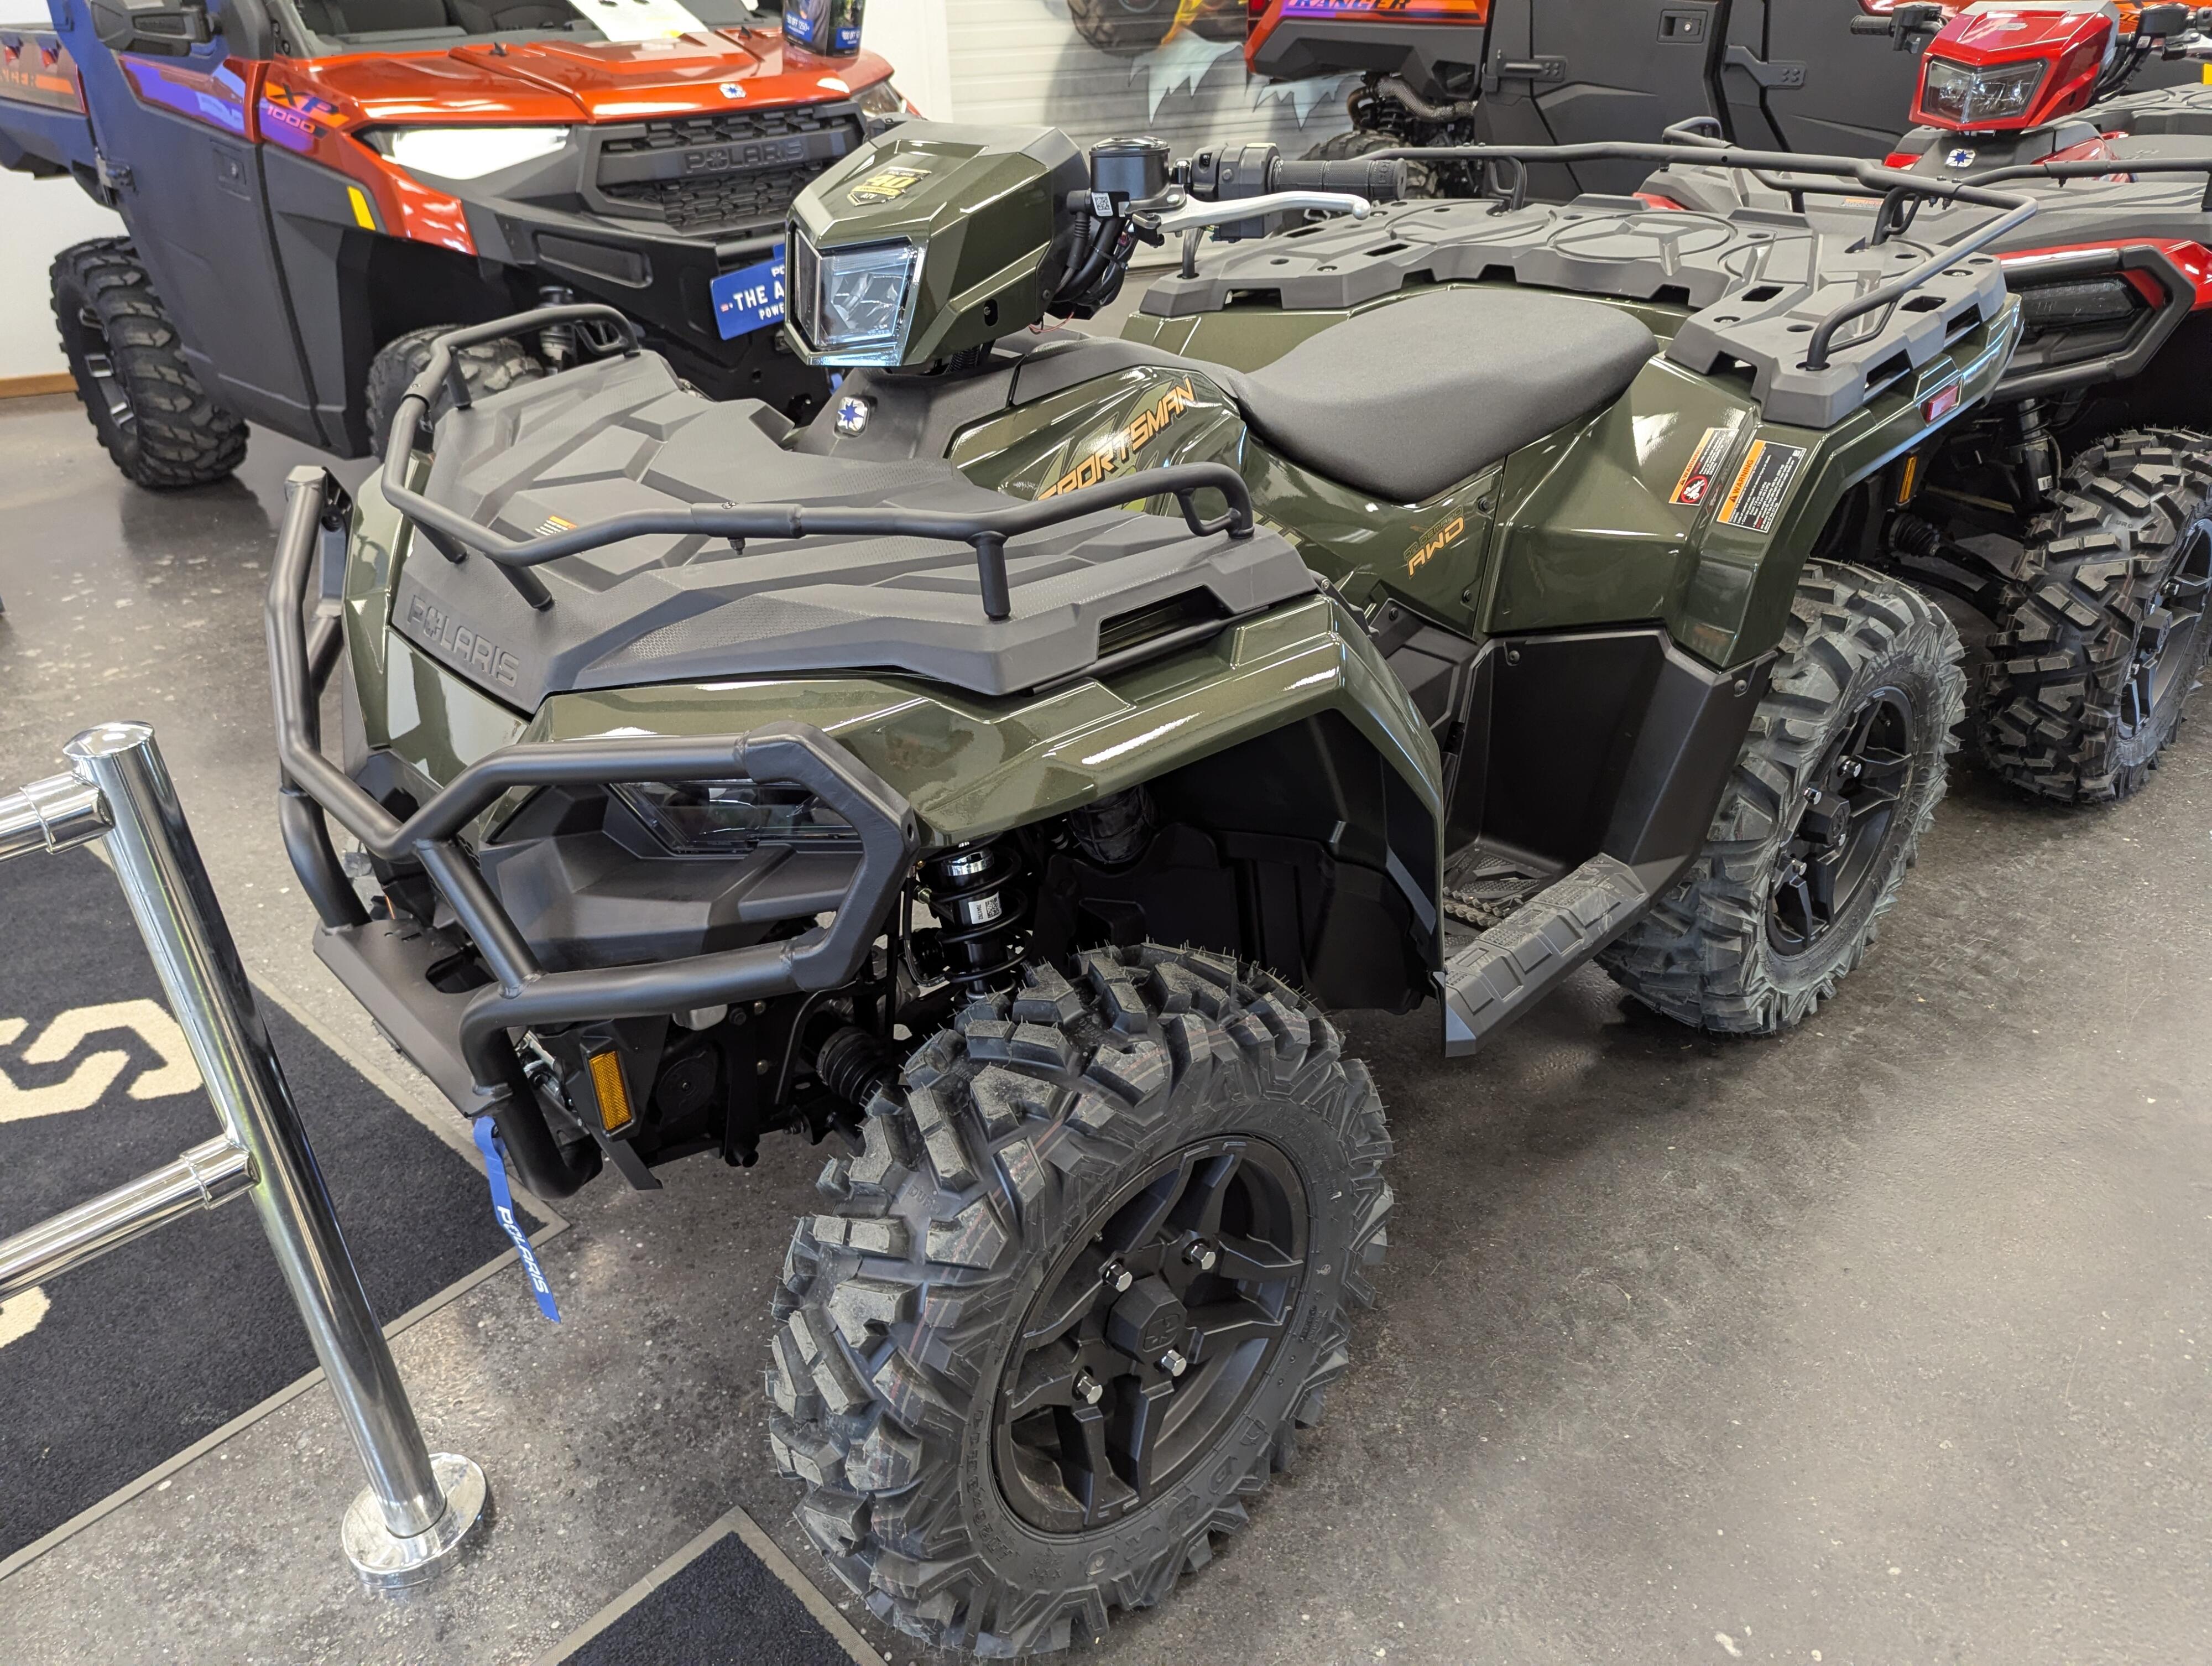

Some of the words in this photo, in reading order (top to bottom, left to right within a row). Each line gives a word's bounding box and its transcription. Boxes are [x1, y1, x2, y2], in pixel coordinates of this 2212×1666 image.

[270, 82, 340, 114] XP
[268, 105, 316, 134] 1000
[685, 140, 804, 174] POLARIS
[866, 175, 917, 189] 40
[733, 284, 768, 311] THE
[1683, 446, 1703, 478] WARNING
[1732, 459, 1754, 494] WARNING
[1404, 542, 1418, 560] ON
[1419, 505, 1463, 545] DEMAND
[1408, 517, 1464, 577] AWD
[408, 594, 519, 688] POLARIS
[907, 1184, 942, 1215] DURO
[497, 1205, 549, 1294] POLARIS
